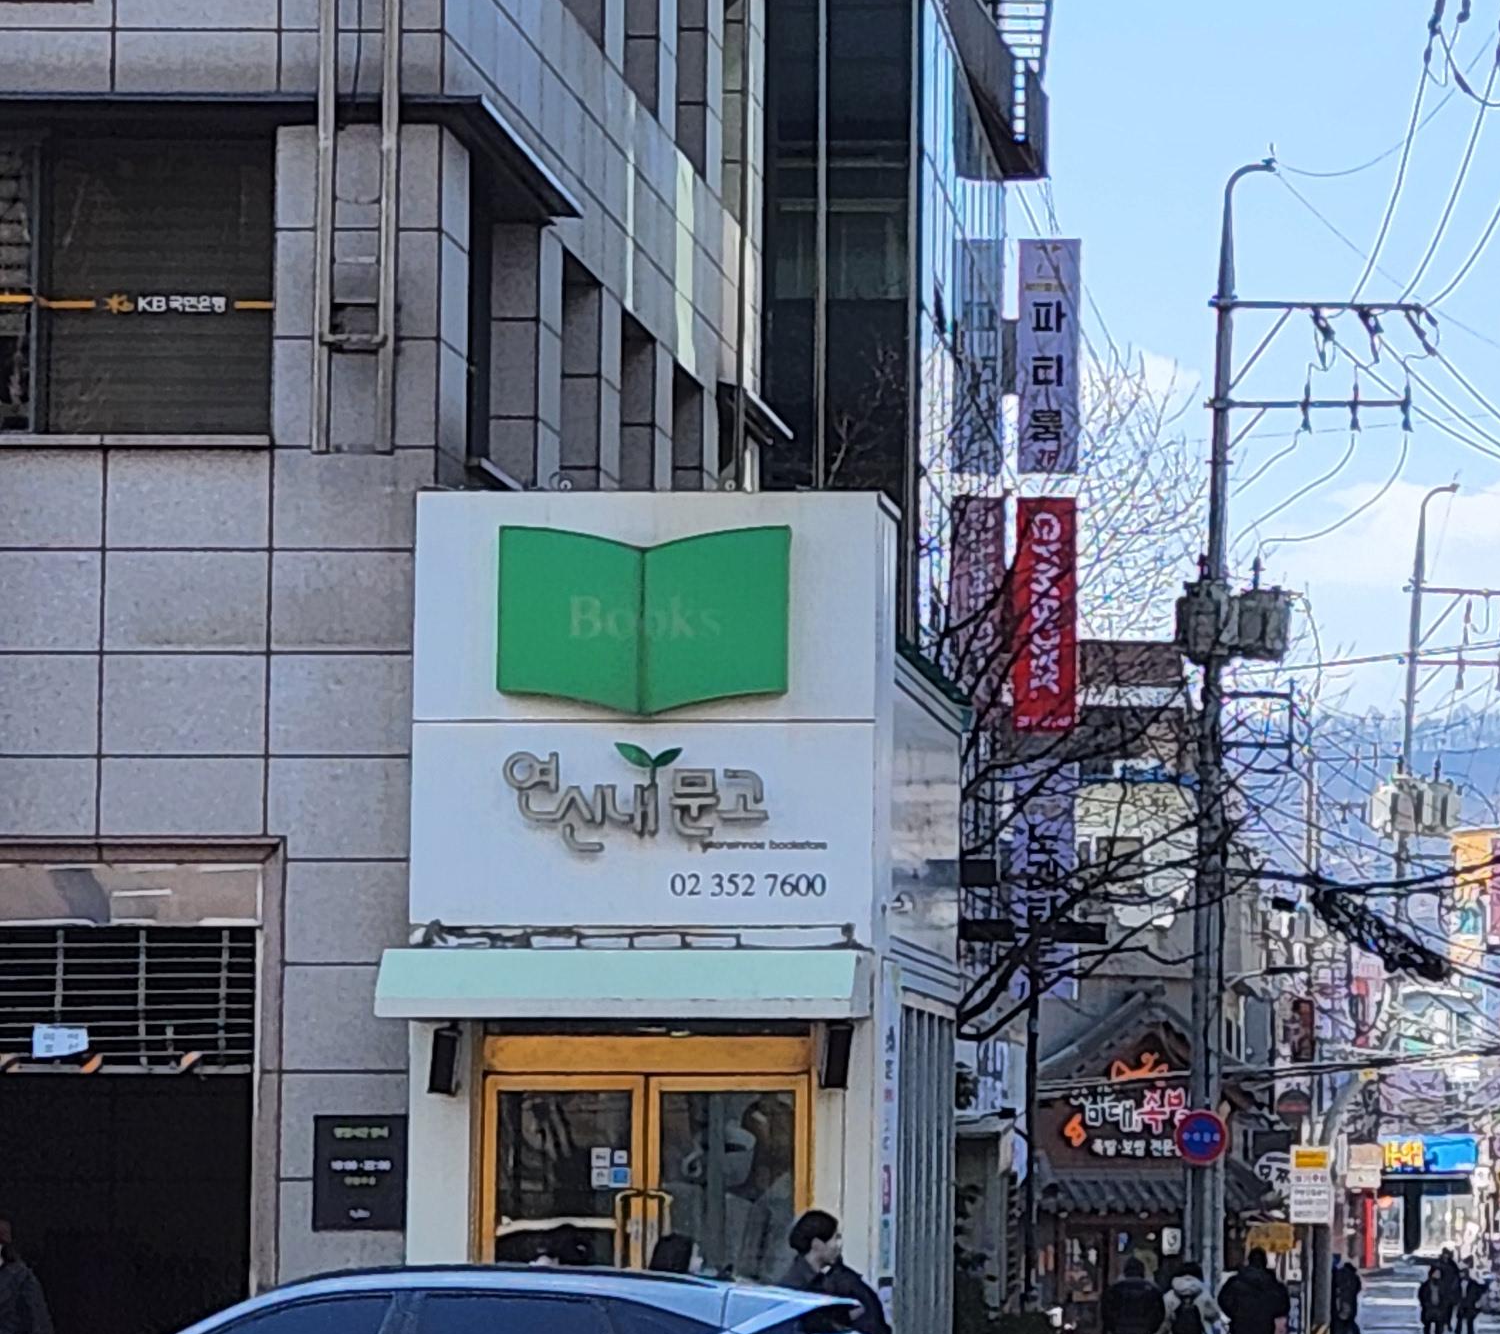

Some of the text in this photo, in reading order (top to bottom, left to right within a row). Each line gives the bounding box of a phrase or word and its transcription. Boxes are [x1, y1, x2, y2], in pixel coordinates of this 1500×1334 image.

[137, 295, 227, 314] KB 국민은행
[570, 595, 721, 640] Books
[670, 873, 827, 897] 02 352 7600
